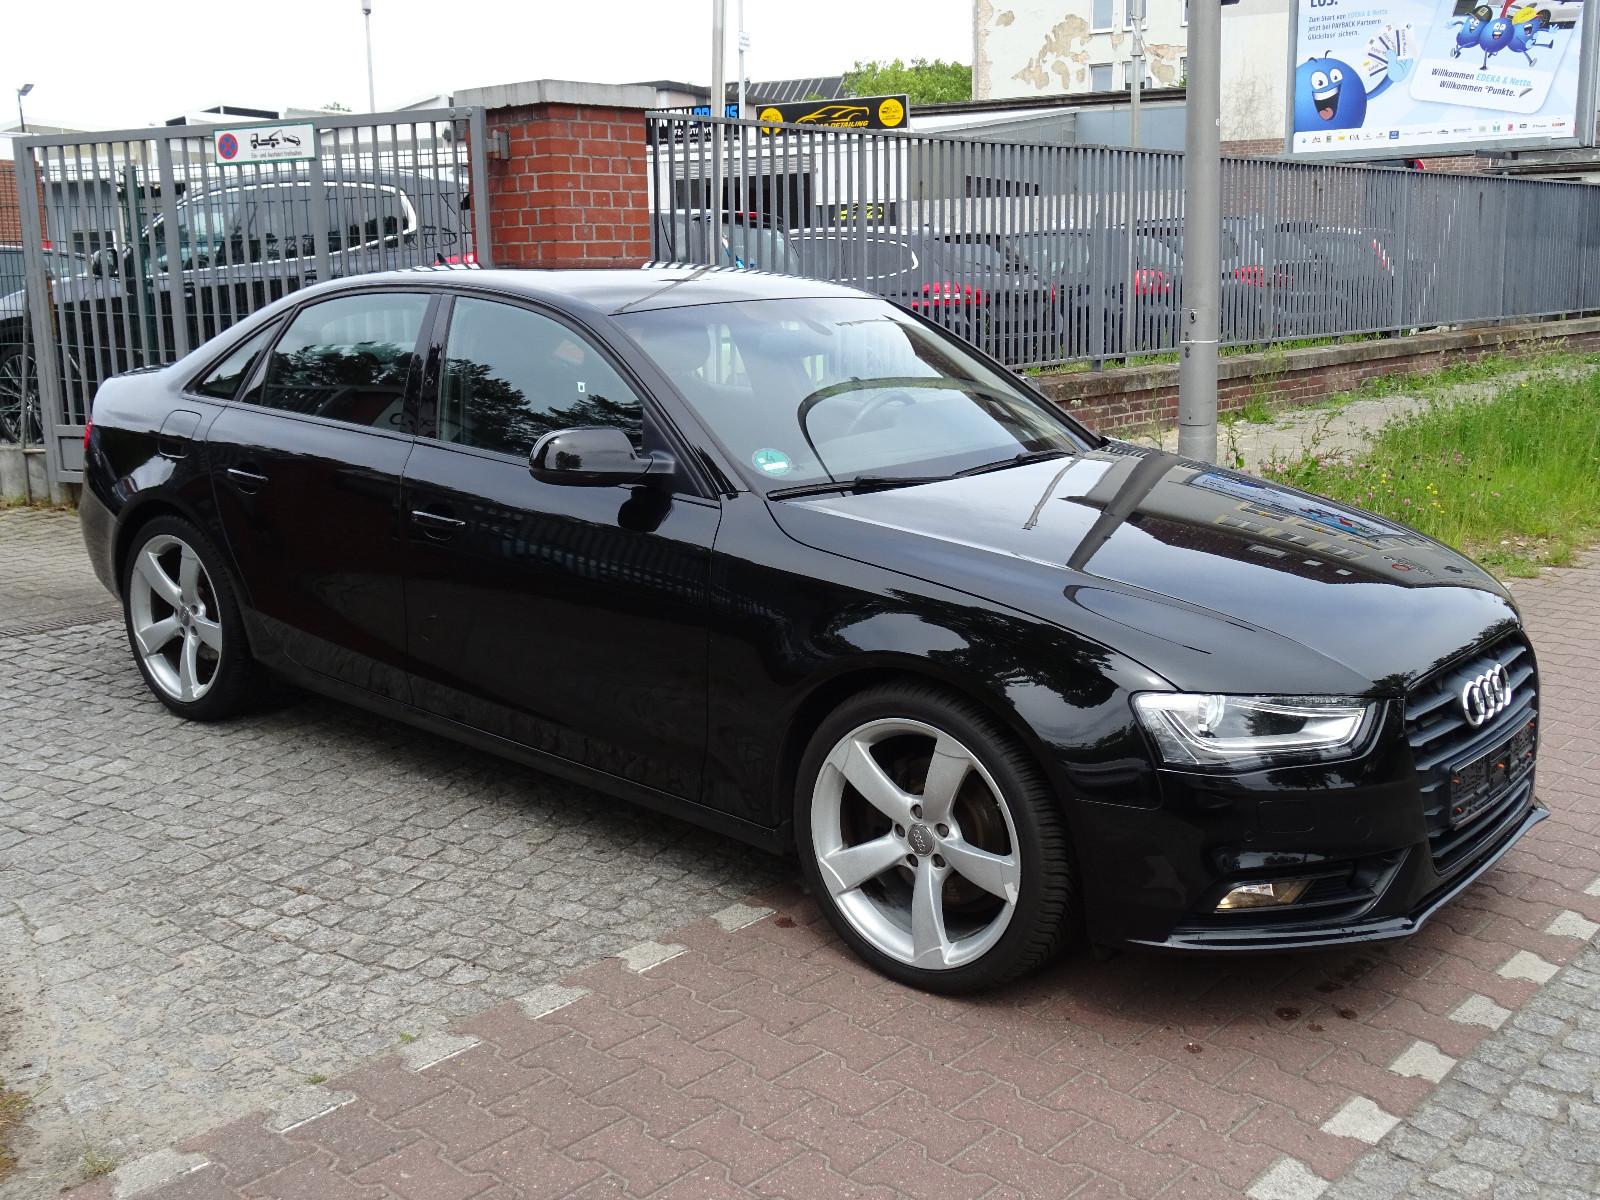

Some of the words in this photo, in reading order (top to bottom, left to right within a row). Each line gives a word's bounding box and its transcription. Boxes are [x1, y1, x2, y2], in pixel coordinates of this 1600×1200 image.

[1331, 20, 1356, 29] PAYBACK
[1431, 68, 1475, 80] Willkommen
[1475, 73, 1500, 82] EDEKA
[1439, 80, 1483, 92] Willkommen
